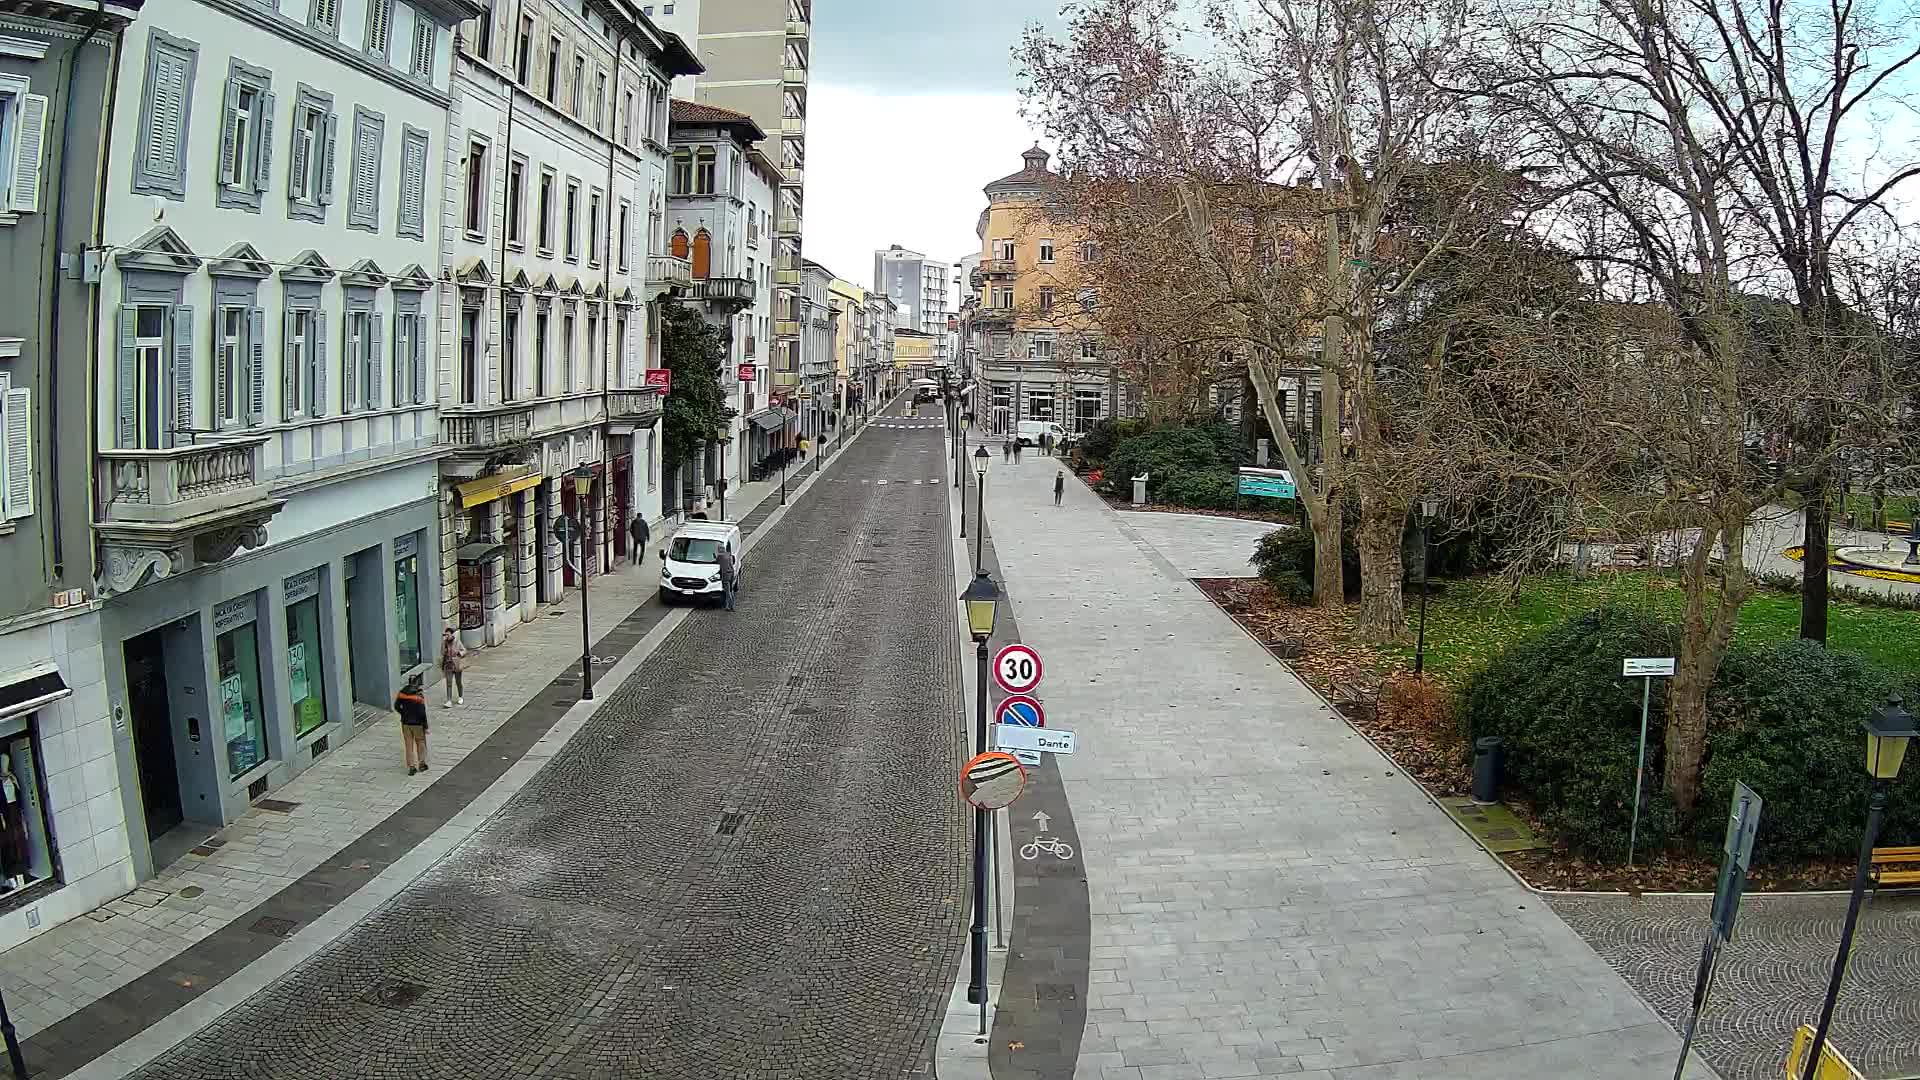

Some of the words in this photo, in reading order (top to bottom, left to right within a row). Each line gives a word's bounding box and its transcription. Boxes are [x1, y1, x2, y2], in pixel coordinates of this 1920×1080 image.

[1005, 658, 1033, 680] 30
[221, 677, 240, 700] 130
[1038, 738, 1069, 749] Dante
